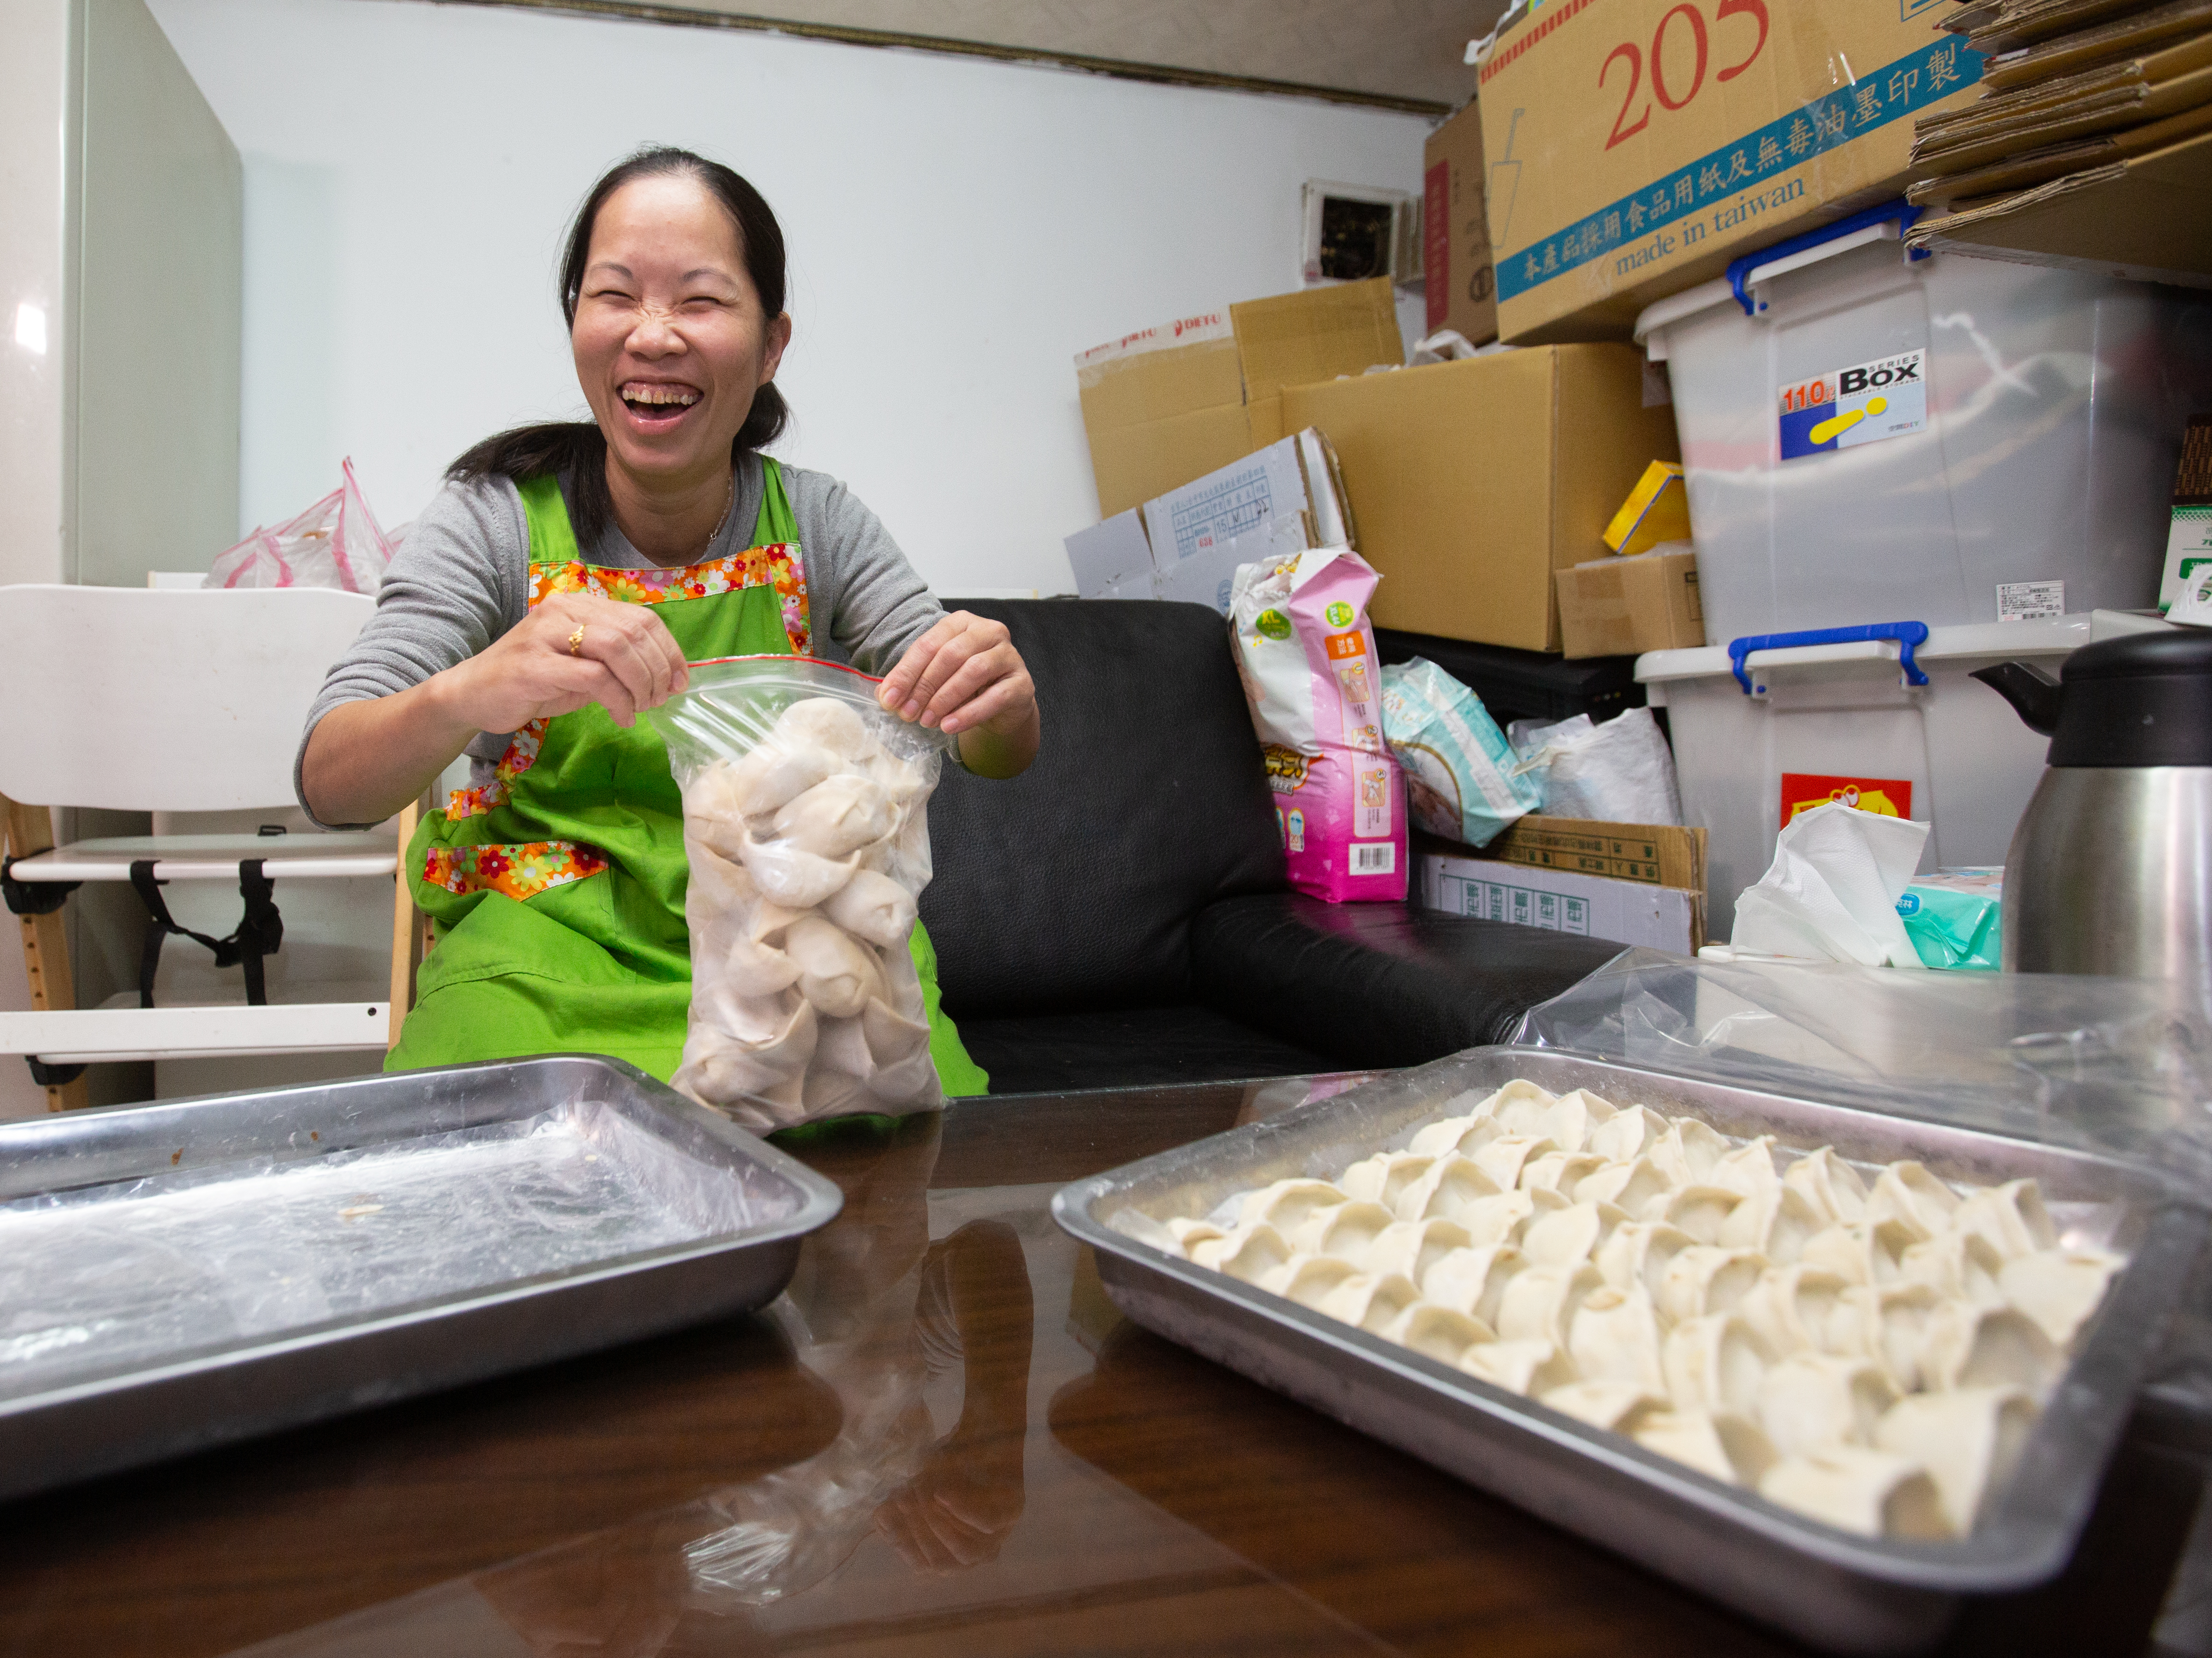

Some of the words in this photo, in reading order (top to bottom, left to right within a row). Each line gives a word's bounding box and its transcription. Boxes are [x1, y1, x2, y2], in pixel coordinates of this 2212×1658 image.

[1598, 0, 1769, 151] 205
[1616, 234, 1676, 276] made
[1683, 222, 1705, 246] in
[1714, 178, 1805, 232] taiwan
[1869, 354, 1919, 372] SERIES
[1263, 610, 1281, 624] XL
